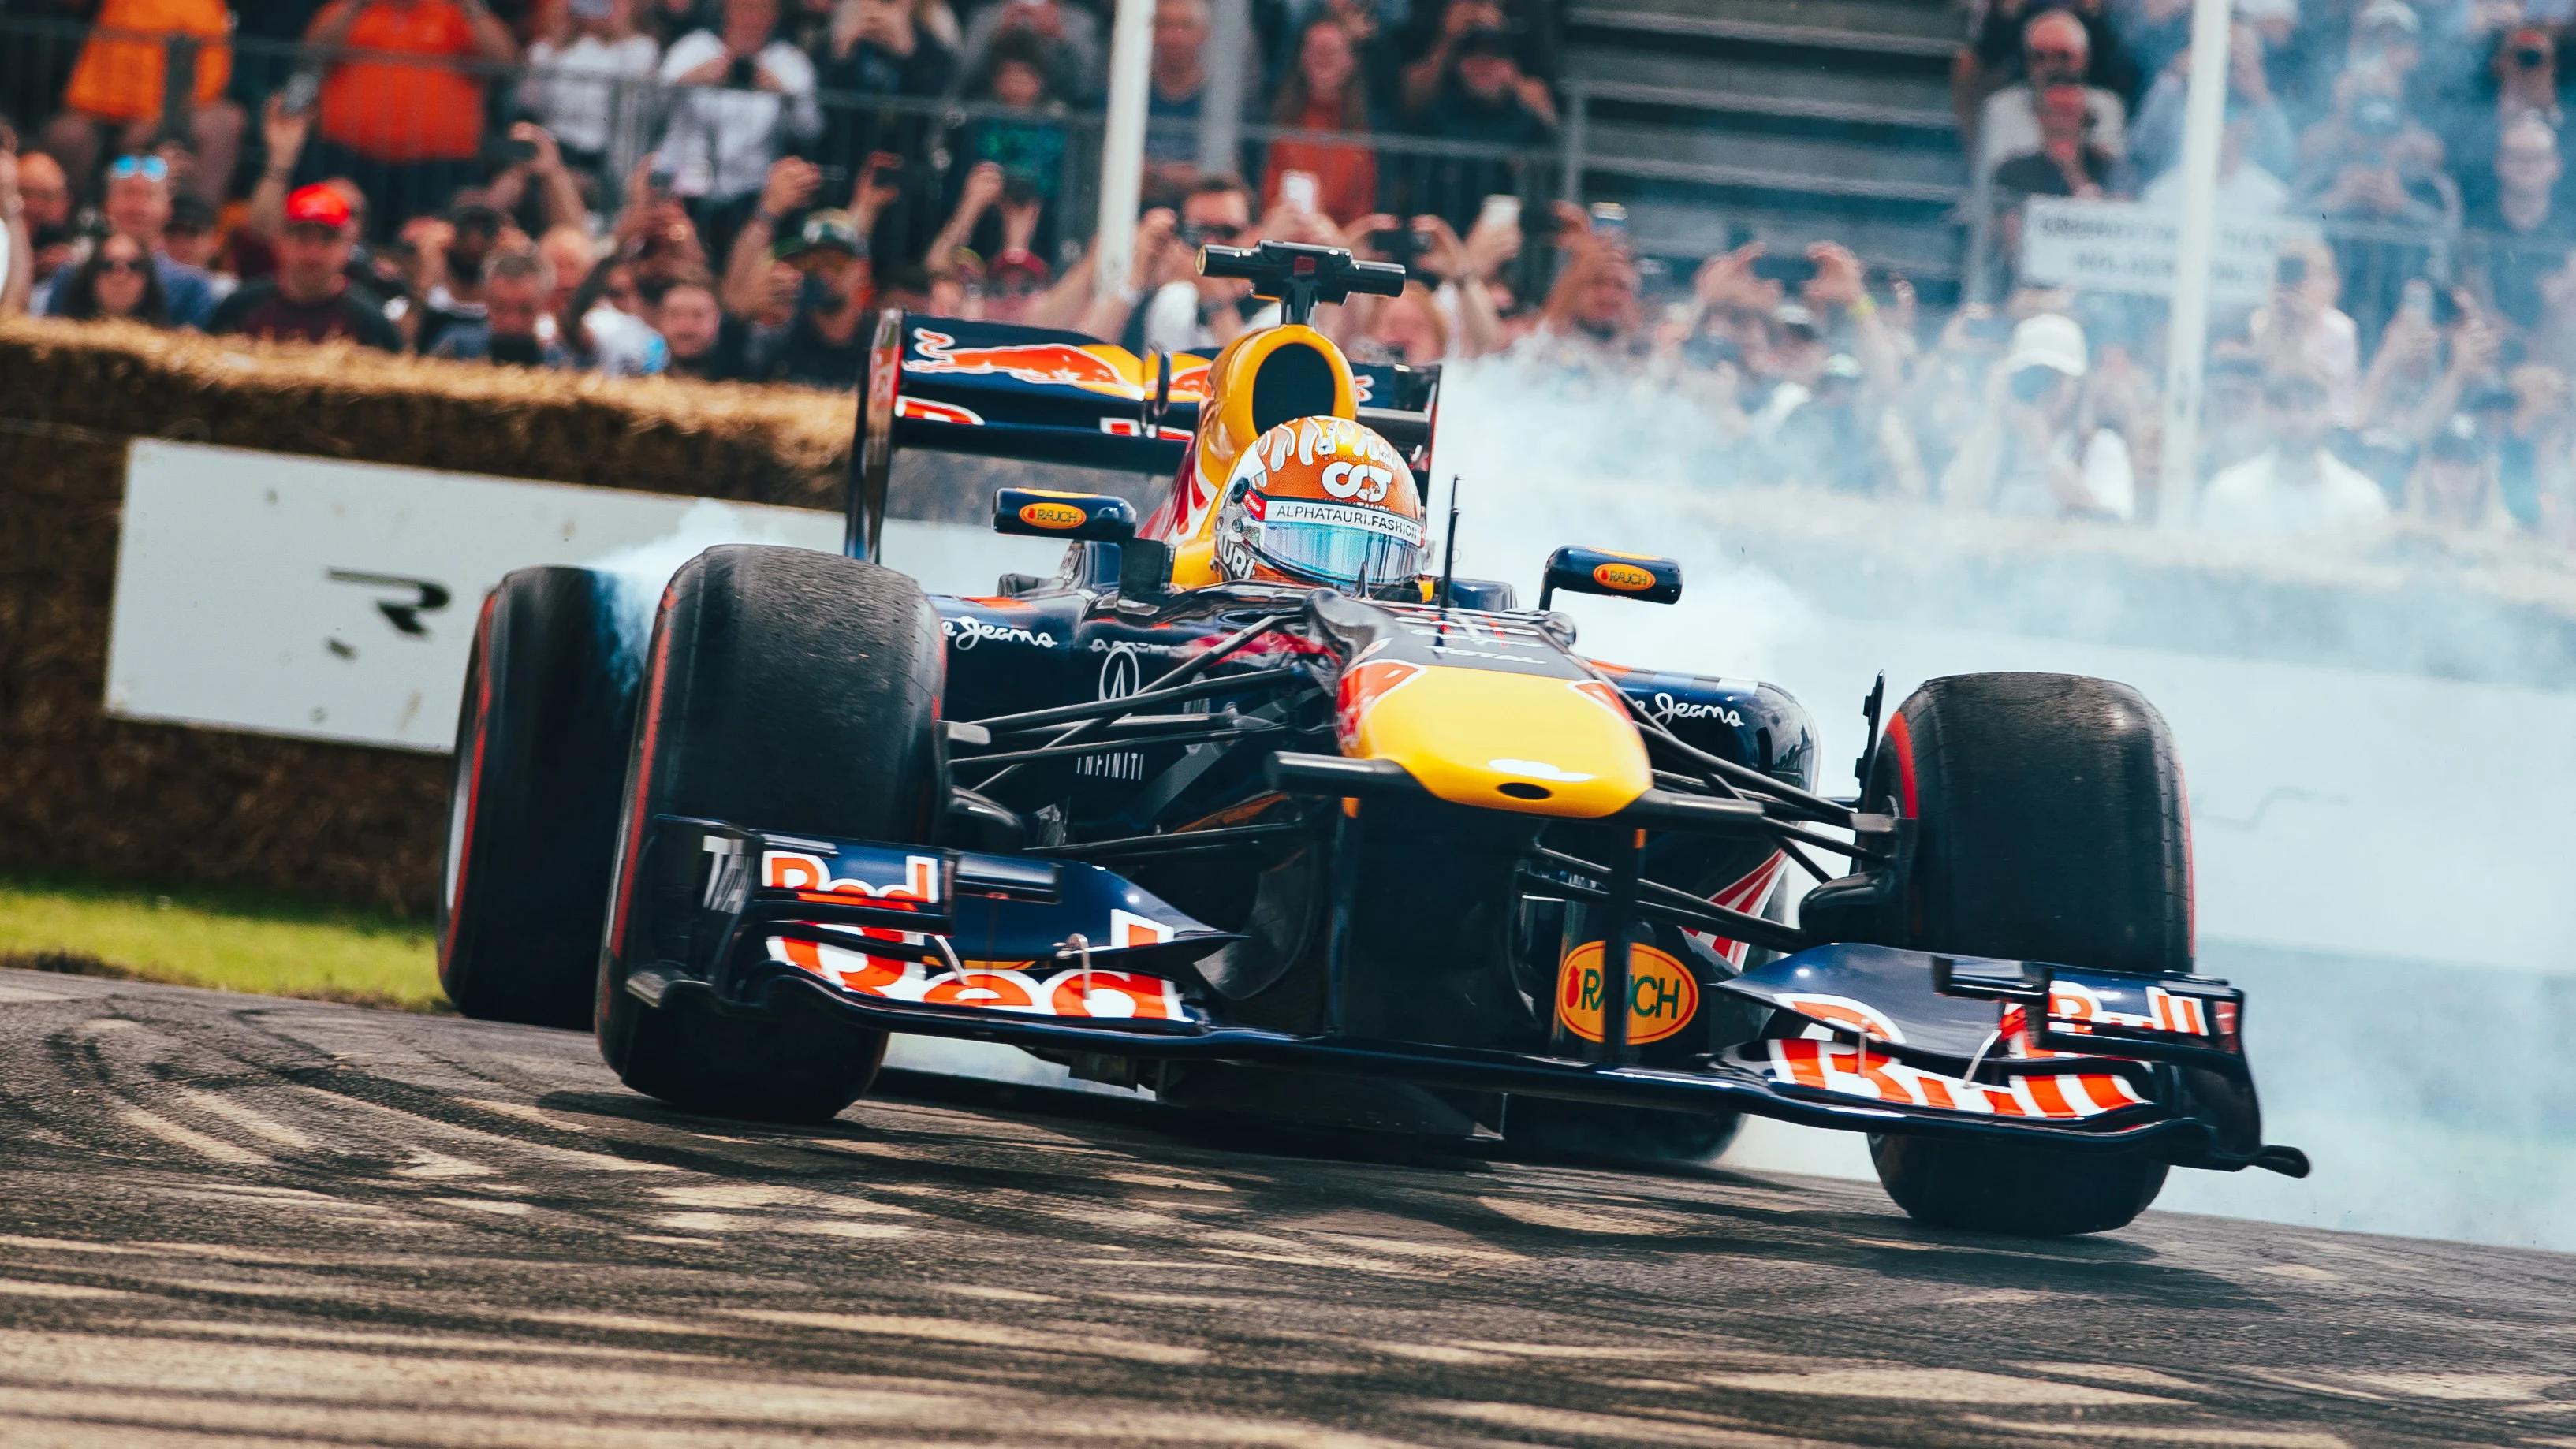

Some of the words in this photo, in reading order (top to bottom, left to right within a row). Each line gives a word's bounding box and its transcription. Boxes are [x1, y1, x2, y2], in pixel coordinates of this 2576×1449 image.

[1037, 508, 1078, 524] RAUCH
[1276, 505, 1417, 542] ALPHATAURI.FASHION
[1609, 570, 1648, 586] RAUCH
[956, 616, 1057, 650] Jeans
[1652, 693, 1745, 727] Jeans
[1076, 752, 1143, 780] INFINITI
[1581, 967, 1681, 1020] RCH
